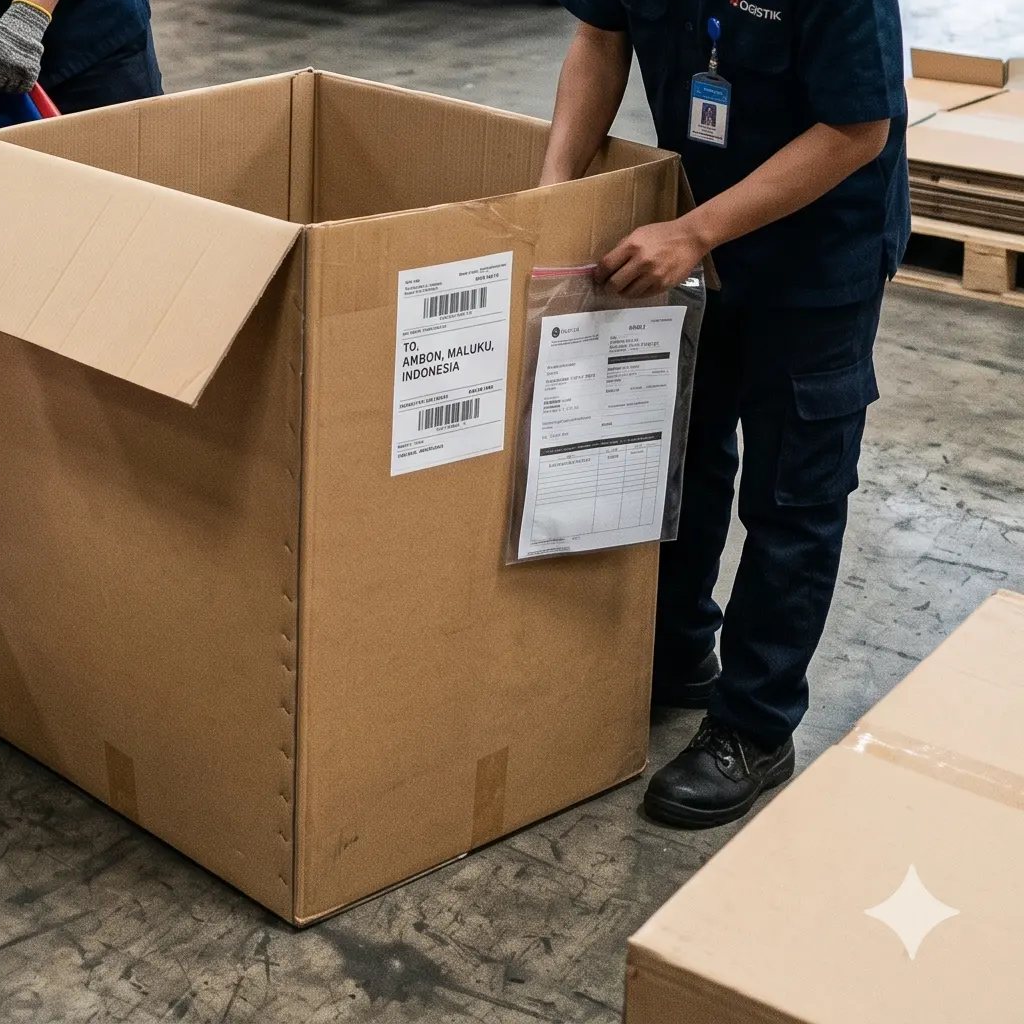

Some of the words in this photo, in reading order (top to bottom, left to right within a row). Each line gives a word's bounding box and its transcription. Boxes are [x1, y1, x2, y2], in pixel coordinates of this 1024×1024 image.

[402, 350, 444, 367] AMBON,
[447, 340, 494, 359] MALUKU,
[402, 361, 459, 382] INDONESIA
